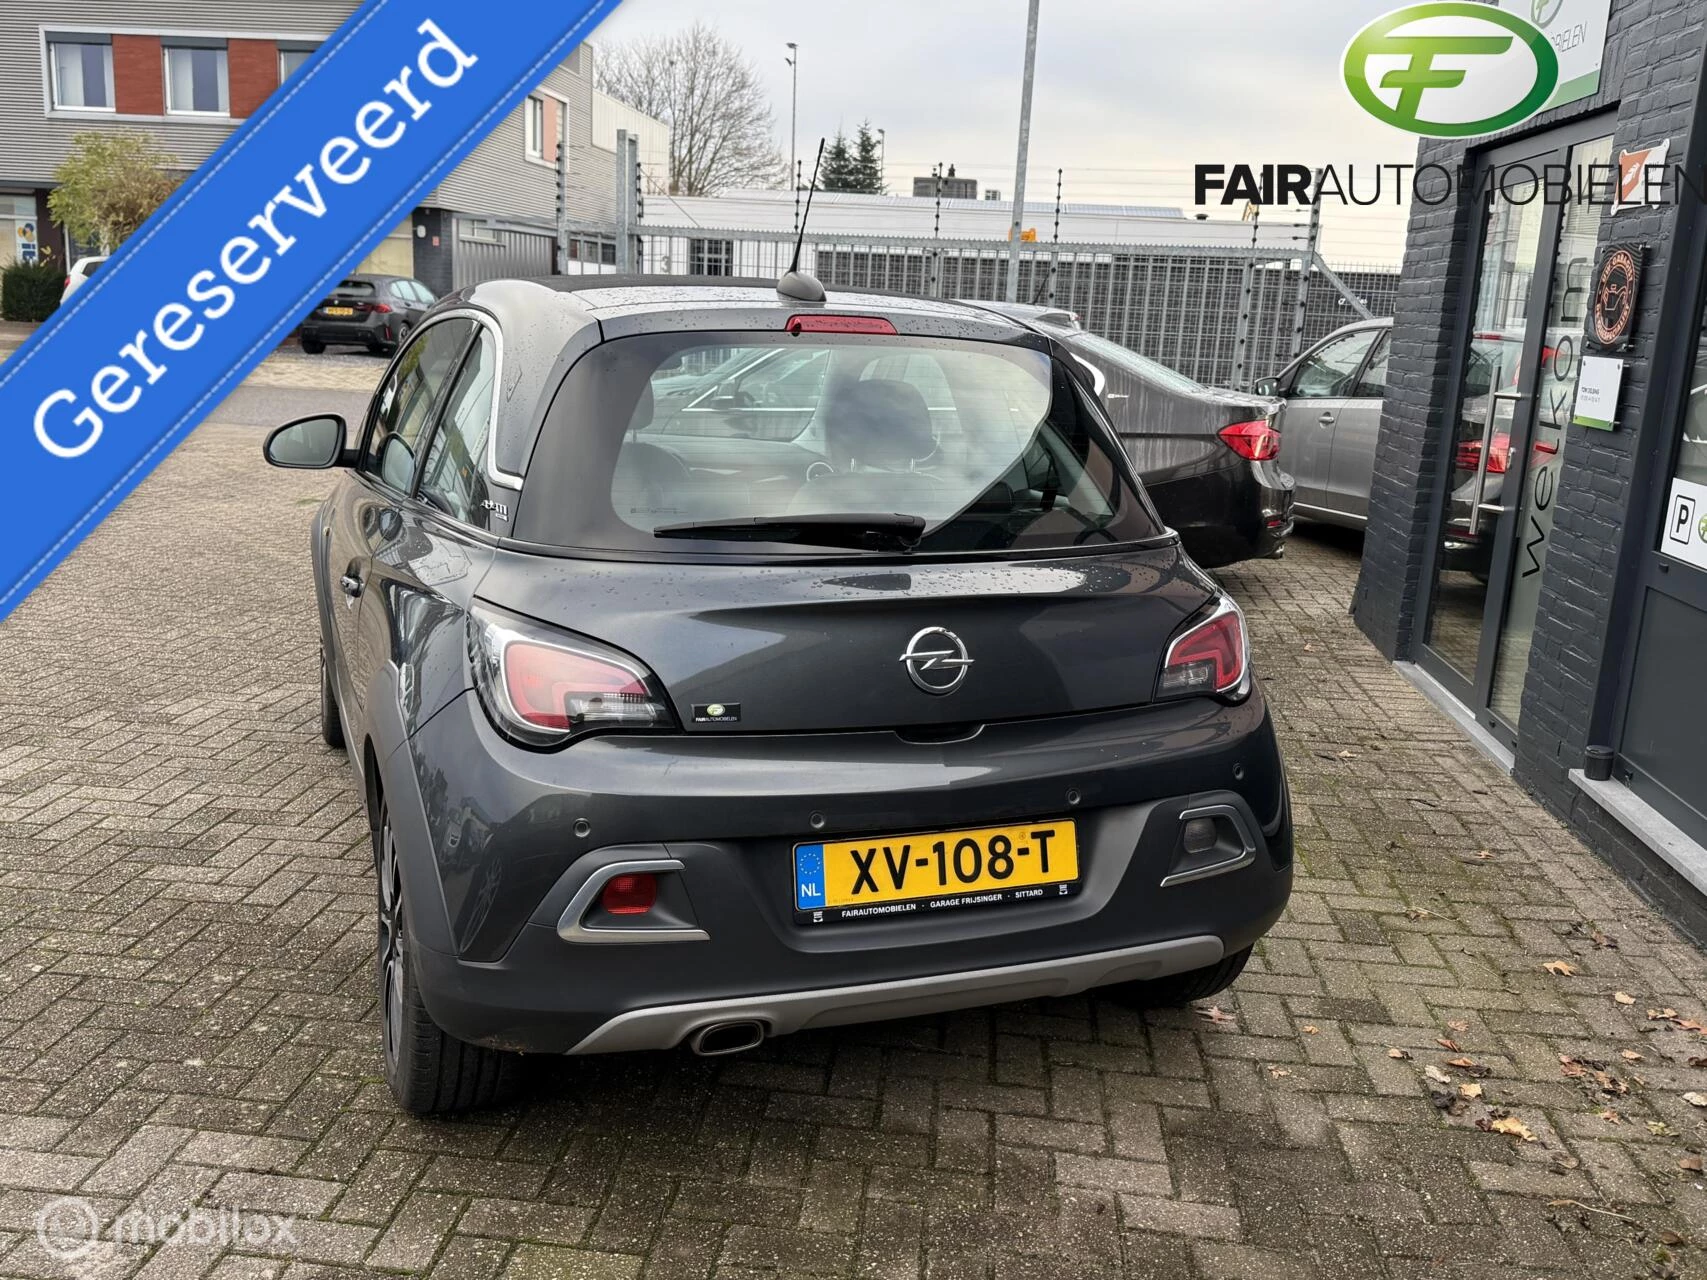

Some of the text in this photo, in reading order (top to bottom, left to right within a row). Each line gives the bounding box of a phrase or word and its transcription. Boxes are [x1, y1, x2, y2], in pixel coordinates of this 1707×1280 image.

[1522, 257, 1588, 578] welkom
[850, 829, 1055, 895] XV-108-T
[801, 883, 821, 898] NL
[841, 889, 1044, 918] FAIRAUTOMOBIELEN GARAGE FRIJSINGER SITTARD
